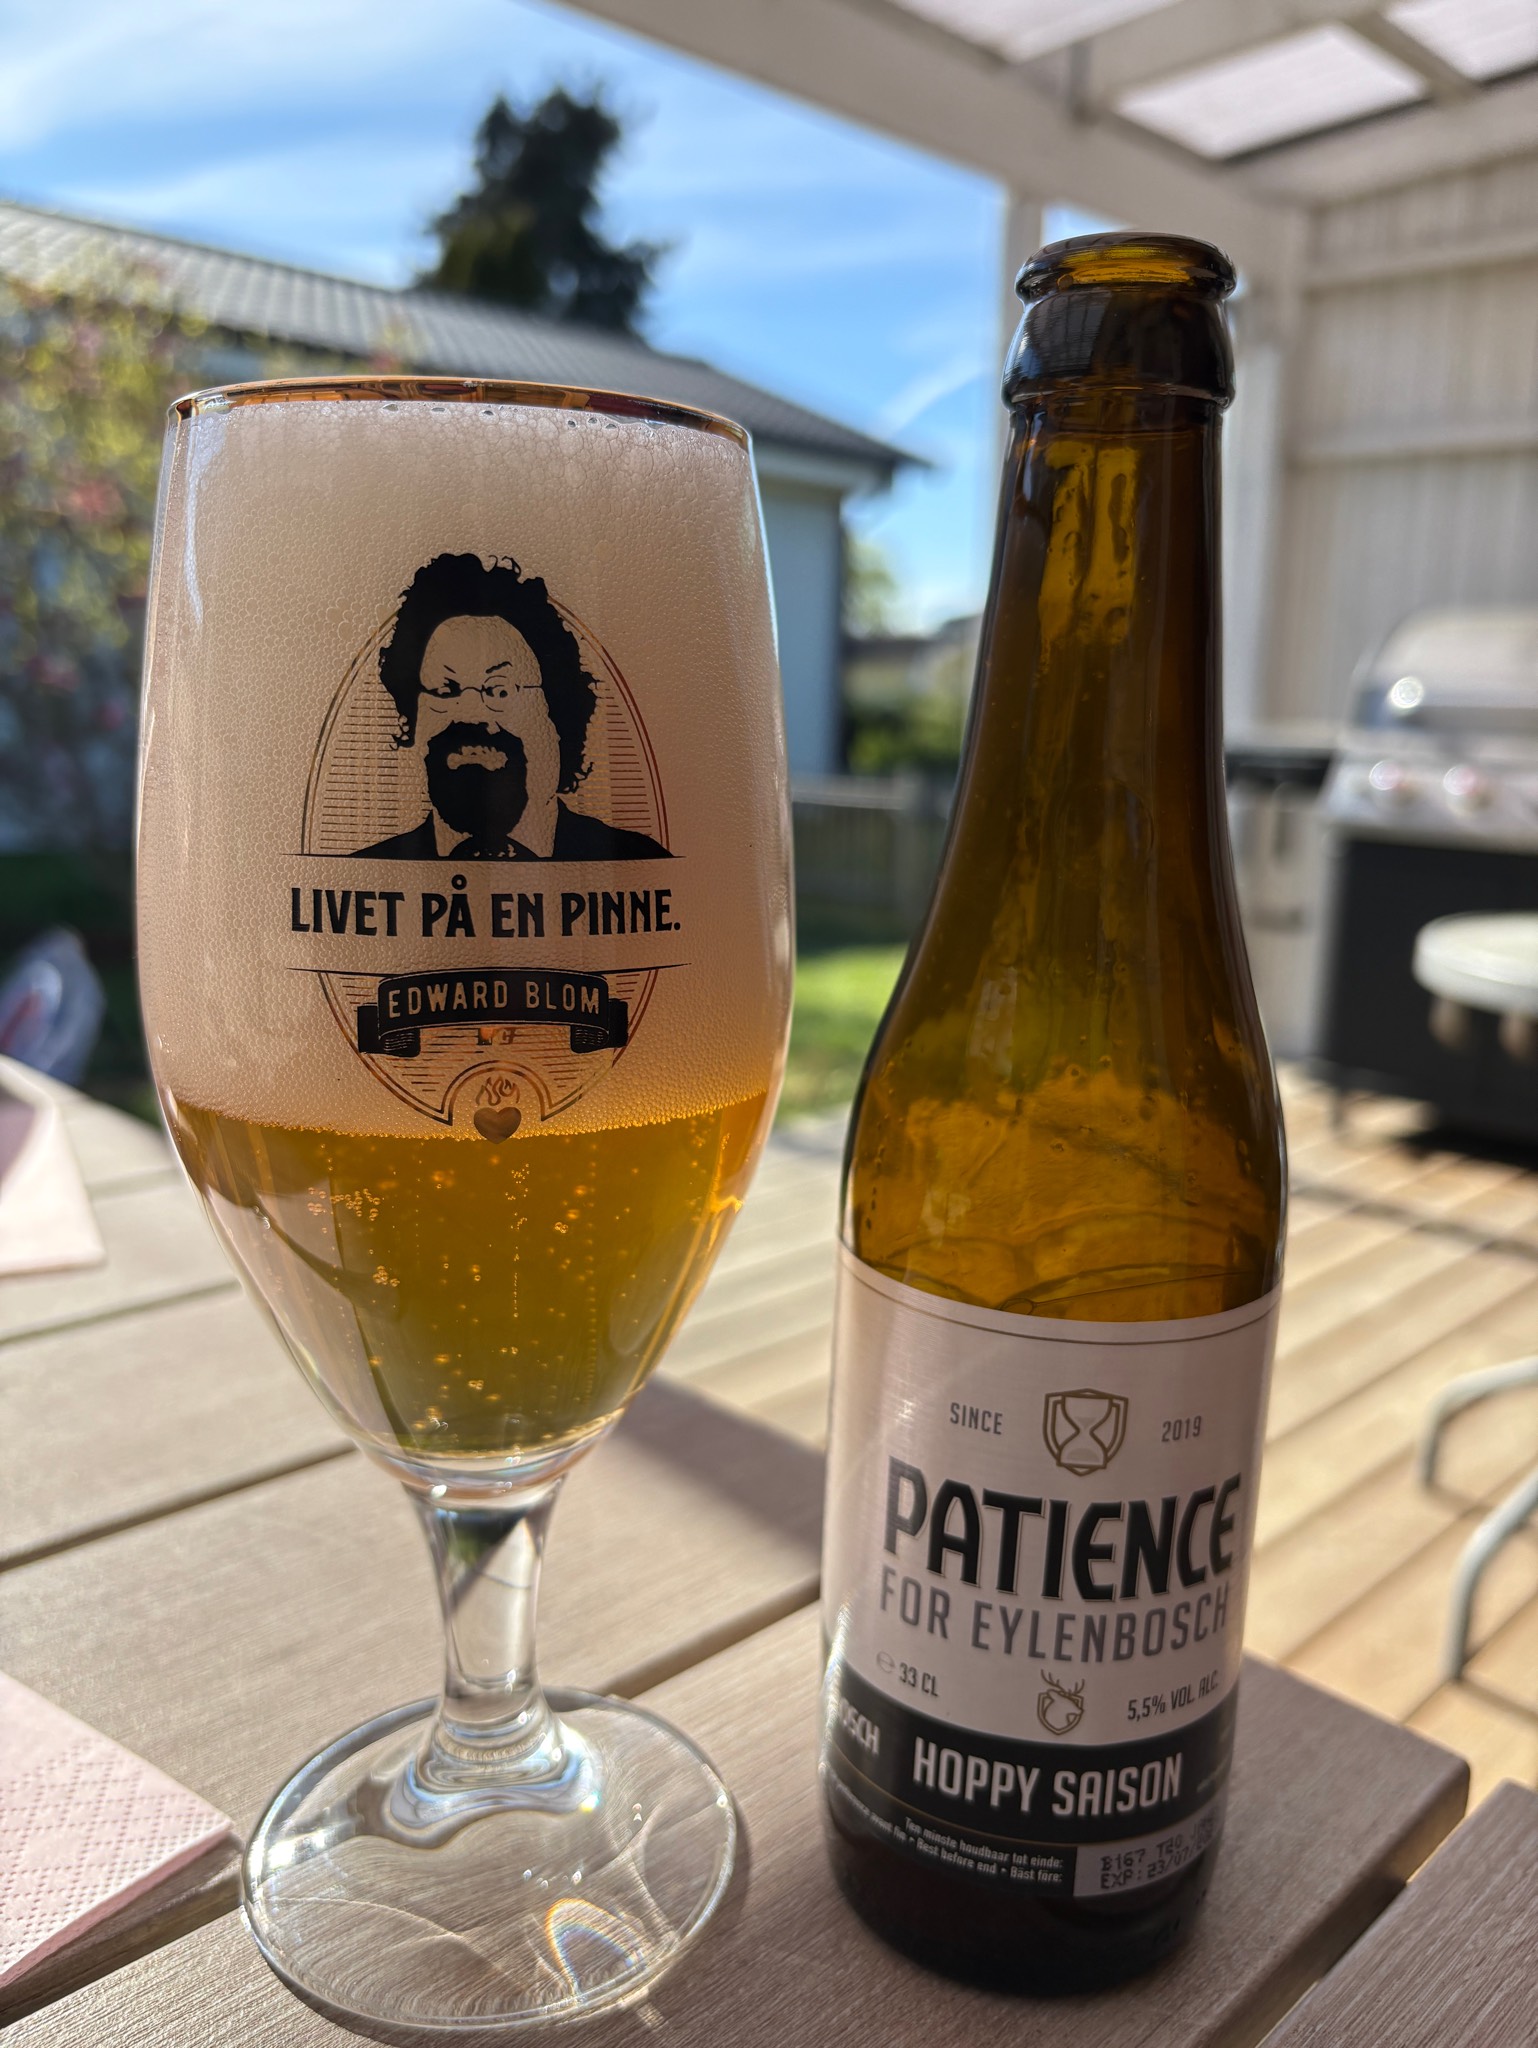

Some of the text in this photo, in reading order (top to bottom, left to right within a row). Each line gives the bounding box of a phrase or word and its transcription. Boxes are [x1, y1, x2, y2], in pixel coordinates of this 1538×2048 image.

[291, 874, 681, 937] LIVET PÅ EN PINNE.
[388, 980, 600, 1018] EDWARD BLOM
[949, 1402, 1202, 1443] SINCE 2019
[883, 1455, 1242, 1601] PATIENCE
[880, 1564, 1228, 1663] FOR EYLENBOSCH
[899, 1662, 918, 1688] 33
[921, 1672, 939, 1697] CL
[1127, 1693, 1166, 1722] 5,5%
[1170, 1683, 1196, 1711] VOL.
[912, 1736, 1041, 1812] HOPPY
[1052, 1752, 1183, 1817] SAISON
[916, 1837, 939, 1855] Best
[940, 1849, 974, 1868] before
[976, 1861, 998, 1875] end
[1010, 1866, 1035, 1881] Bäst
[959, 1839, 1010, 1862] houdbaar
[1012, 1852, 1028, 1864] tot
[1030, 1855, 1064, 1868] einde:
